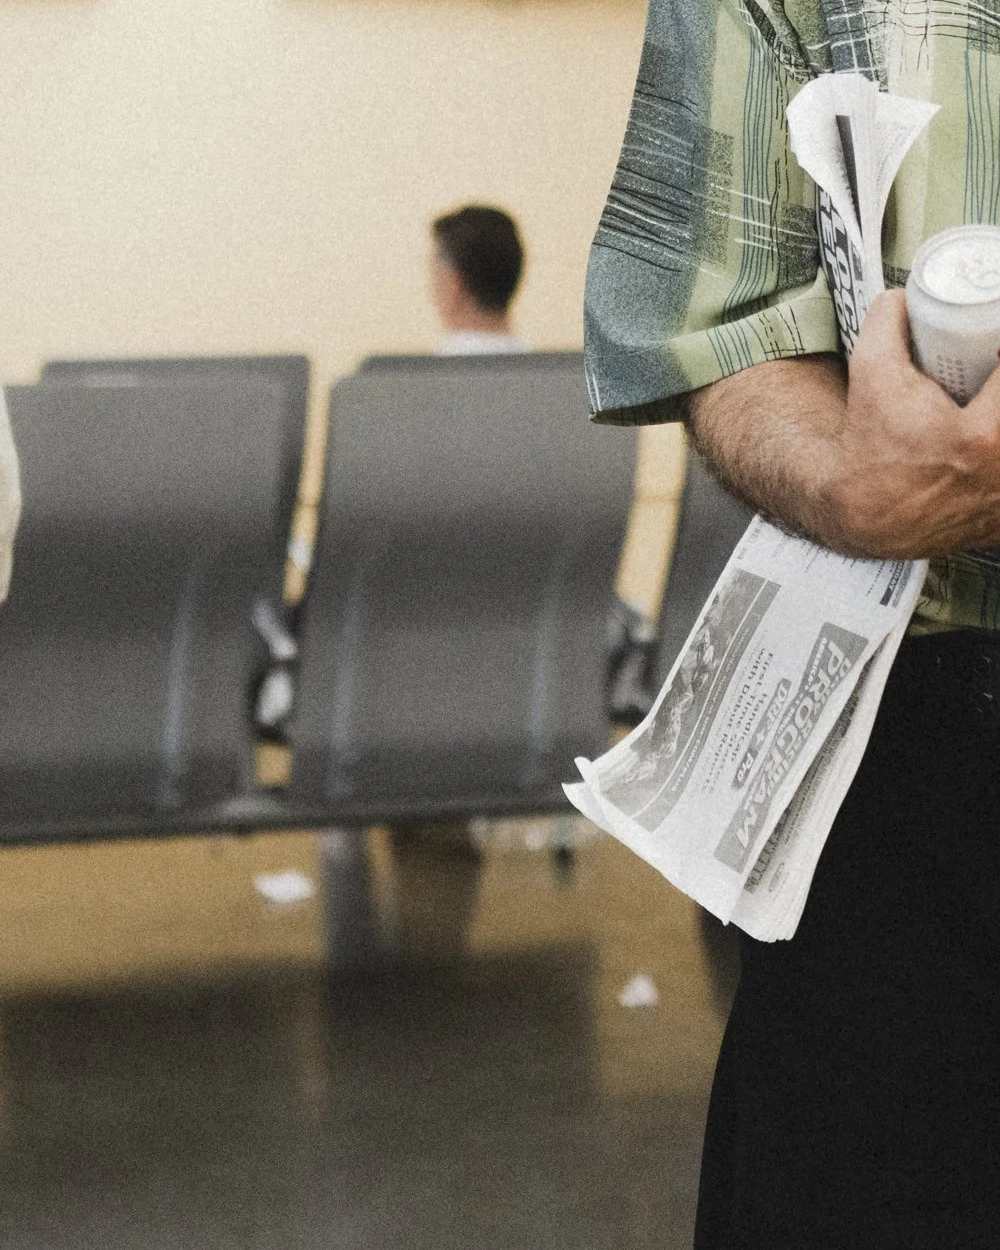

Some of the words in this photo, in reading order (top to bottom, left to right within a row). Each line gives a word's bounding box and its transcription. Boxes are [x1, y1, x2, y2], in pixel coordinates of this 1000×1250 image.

[734, 651, 774, 729] First-Time
[746, 647, 766, 680] with
[726, 684, 749, 727] Debut
[728, 692, 768, 762] Handicap
[765, 683, 788, 730] DRF
[700, 733, 727, 791] Reports
[707, 732, 737, 795] Starters
[735, 640, 845, 849] PROGRAM
[736, 752, 753, 781] Pro
